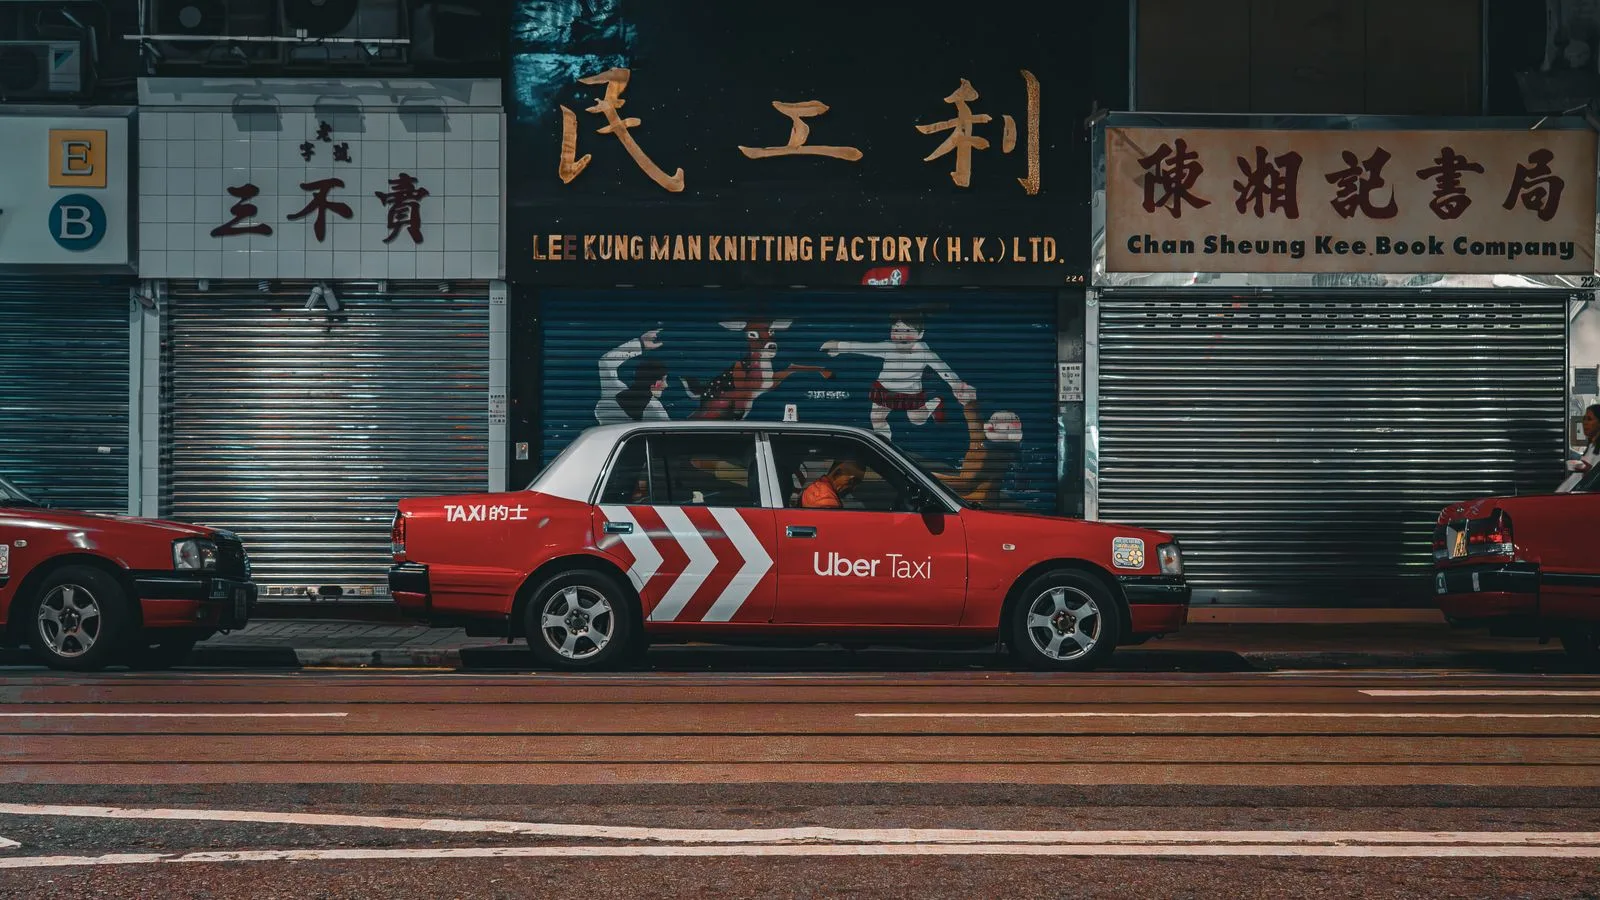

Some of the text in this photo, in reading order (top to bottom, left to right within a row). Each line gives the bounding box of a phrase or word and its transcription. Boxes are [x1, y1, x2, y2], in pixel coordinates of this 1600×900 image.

[62, 140, 93, 175] E
[1137, 138, 1566, 222] 陳湘記書局
[60, 205, 93, 239] B
[532, 234, 577, 261] LEE
[583, 234, 644, 262] KUNG
[649, 234, 702, 262] MAN
[708, 234, 814, 262] KNITTING
[820, 235, 929, 263] FACTORY
[1012, 236, 1065, 264] LTD.
[1127, 234, 1195, 255] Chan
[1203, 234, 1306, 259] Sheung
[1375, 234, 1445, 256] Book
[1453, 235, 1576, 261] Company
[443, 504, 529, 522] TAXI 的士
[813, 551, 932, 579] Uber Taxi
